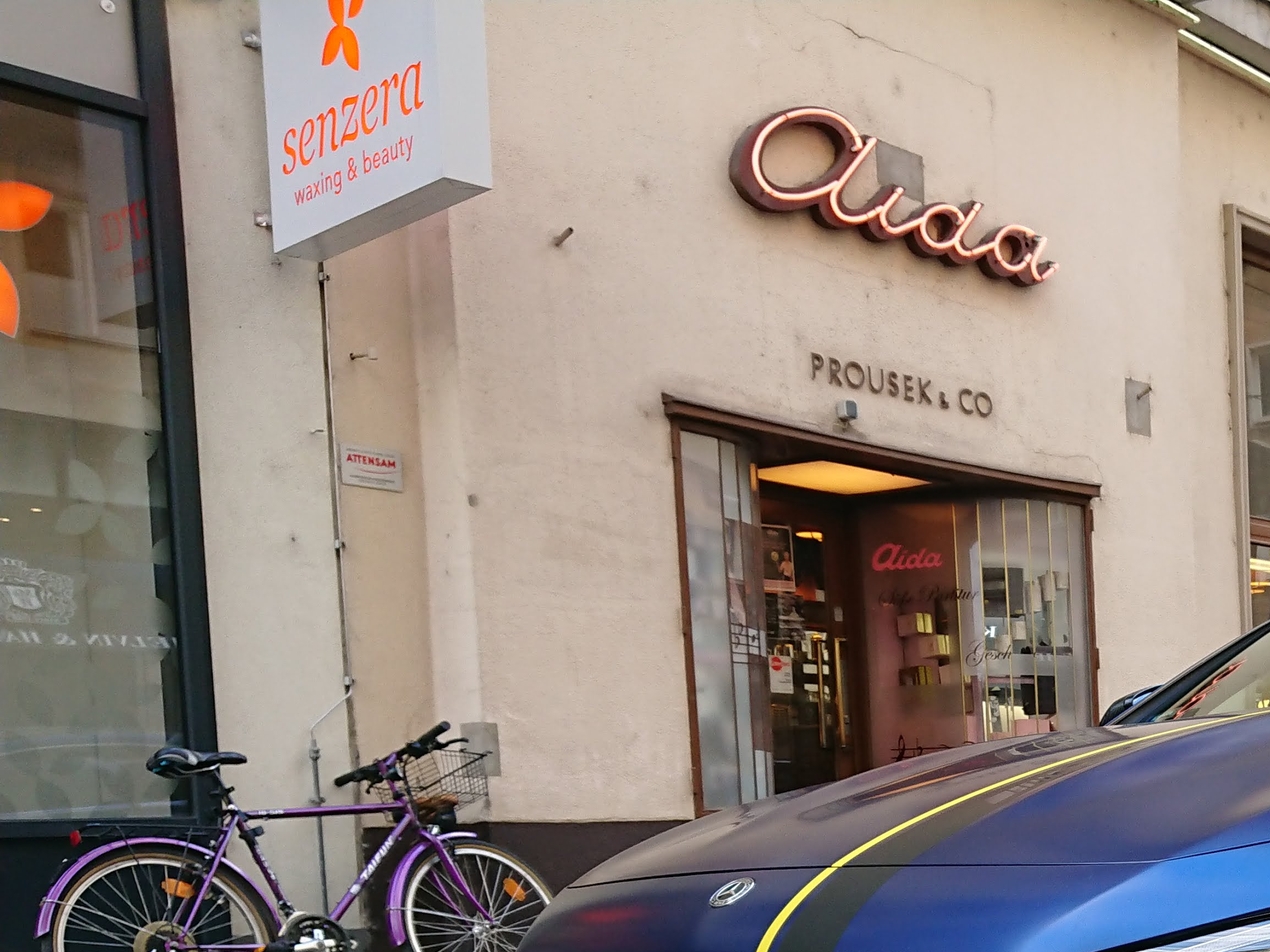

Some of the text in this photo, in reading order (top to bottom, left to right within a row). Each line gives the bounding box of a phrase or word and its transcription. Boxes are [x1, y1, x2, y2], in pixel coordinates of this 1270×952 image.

[282, 60, 424, 176] senzera
[294, 134, 414, 206] waxing & beauty
[810, 352, 993, 418] PROUSEK & CO
[346, 453, 396, 469] ATTENSAM
[360, 834, 395, 882] TAIFUN
